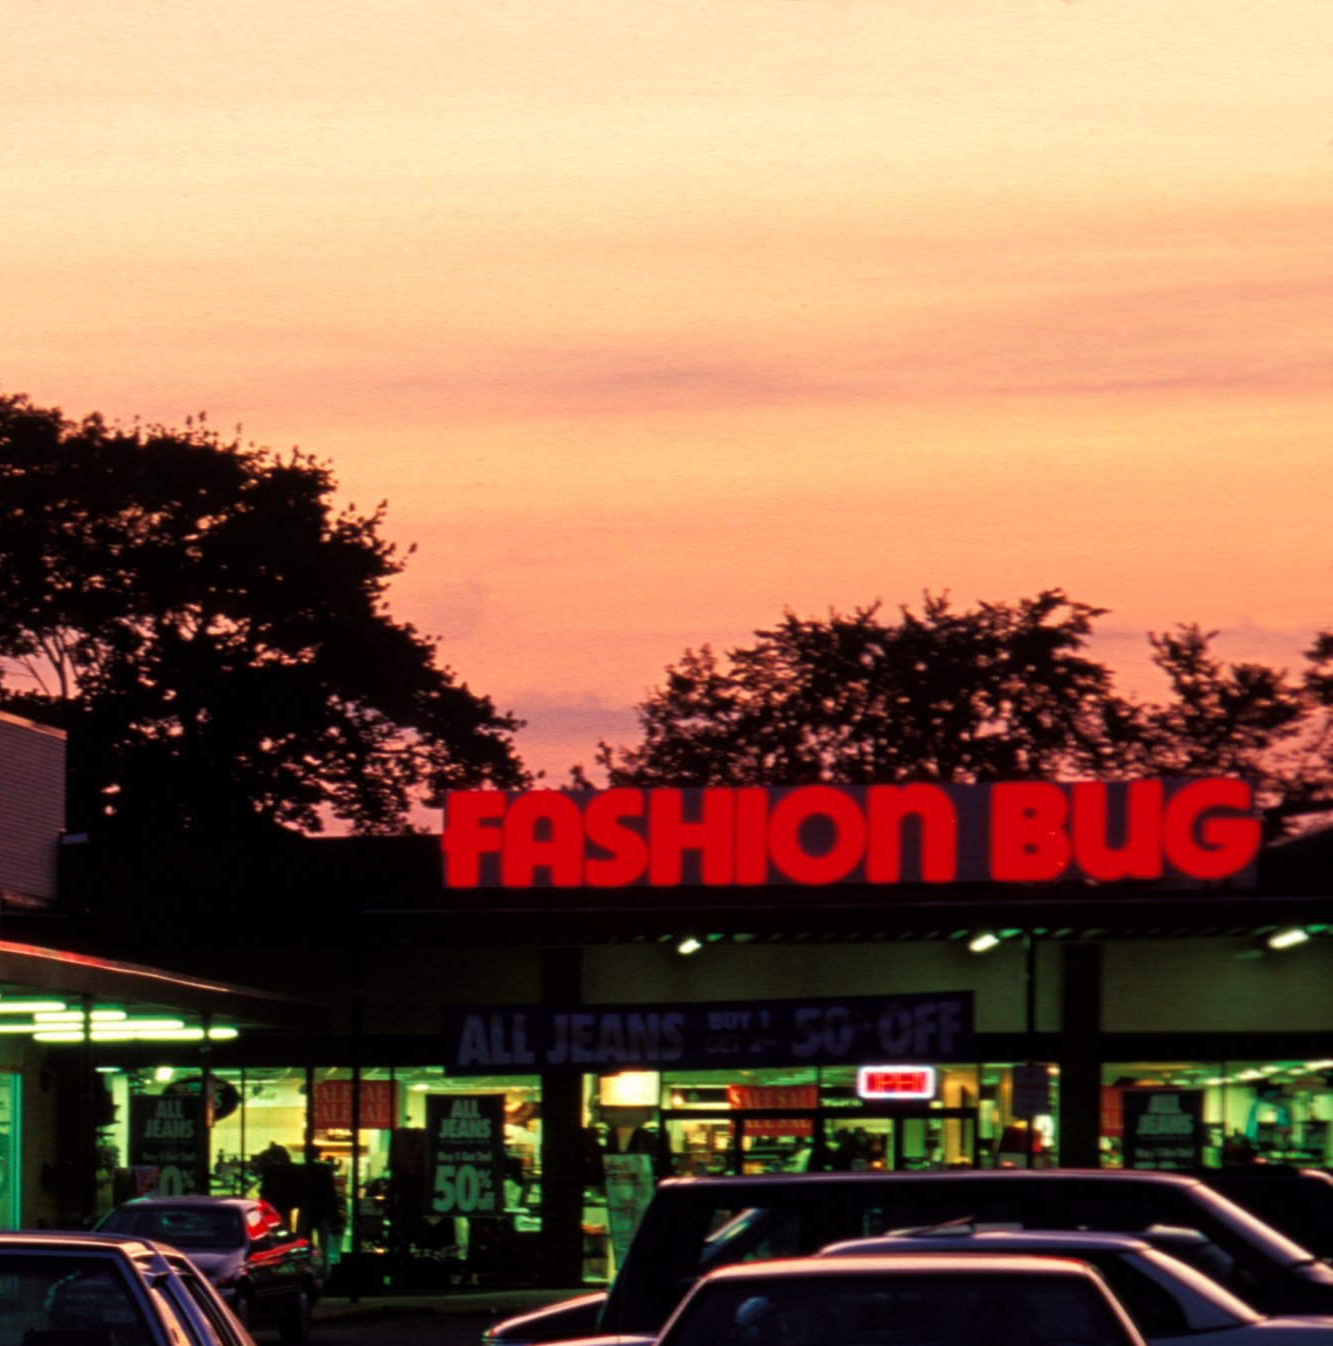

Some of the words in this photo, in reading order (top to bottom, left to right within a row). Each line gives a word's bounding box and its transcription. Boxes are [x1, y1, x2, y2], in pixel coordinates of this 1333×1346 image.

[441, 781, 958, 889] FASHION
[990, 778, 1264, 885] BUG
[707, 1009, 753, 1031] BUY
[455, 1013, 539, 1068] ALL
[545, 1010, 687, 1066] JEANS
[876, 1000, 963, 1056] OFF
[154, 1100, 185, 1118] ALL
[450, 1099, 481, 1118] ALL
[143, 1119, 196, 1139] JEANS
[438, 1118, 493, 1139] JEANS
[1135, 1113, 1195, 1135] JEANS
